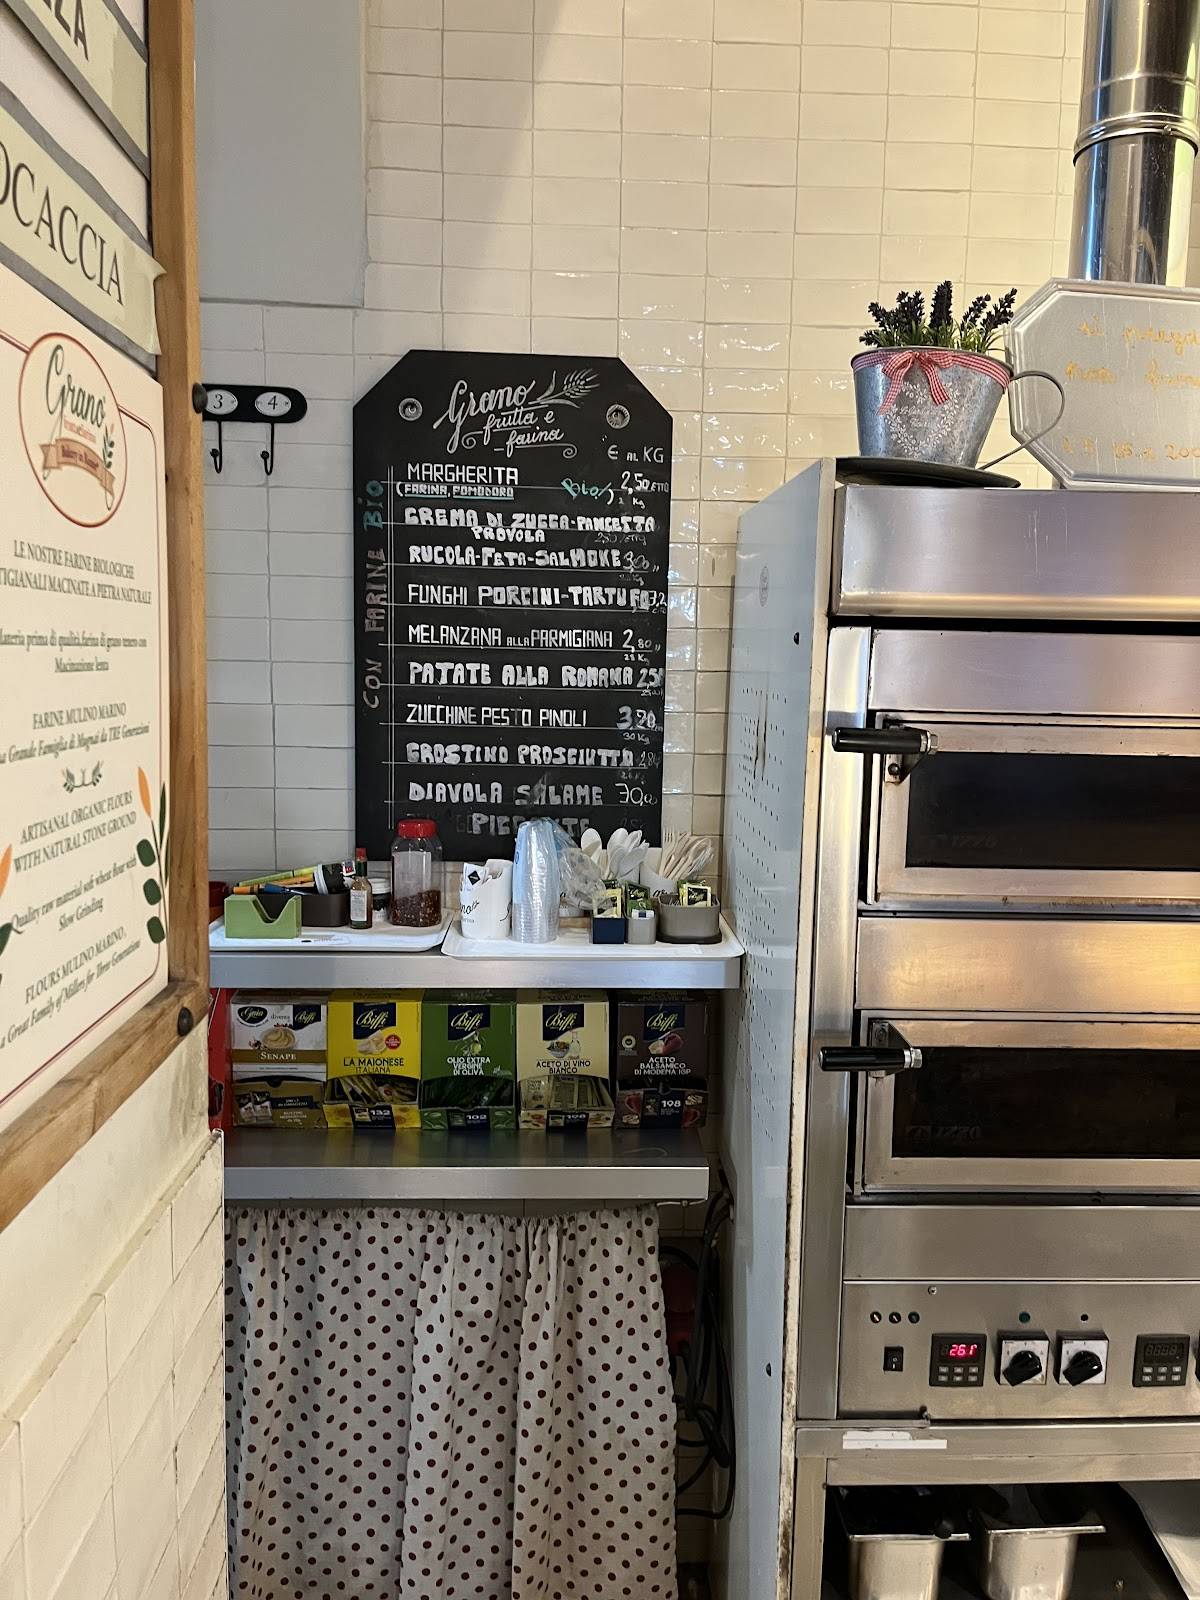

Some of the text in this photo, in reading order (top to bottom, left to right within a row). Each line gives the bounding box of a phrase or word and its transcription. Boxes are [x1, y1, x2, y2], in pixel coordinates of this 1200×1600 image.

[43, 0, 89, 61] ZA
[213, 393, 223, 410] 3
[267, 395, 278, 410] 4
[432, 380, 536, 454] Grano
[482, 406, 556, 446] frutta e
[505, 426, 565, 458] farina
[626, 452, 639, 462] AL
[643, 446, 664, 463] KG
[407, 462, 519, 486] MARGHERITA
[452, 485, 514, 500] POMODORO
[404, 507, 479, 527] CREMA
[486, 512, 503, 528] DI
[471, 525, 546, 543] PROVOLA
[14, 539, 135, 580] LE NOSTRE FARINE BIOLOGICHE
[48, 574, 90, 597] MACINATE
[97, 583, 121, 600] PIETRA
[364, 548, 388, 634] FARINE
[408, 583, 468, 606] FUNGHI
[408, 624, 502, 646] MELANZANA
[506, 635, 530, 647] ALLA
[530, 629, 613, 648] PARMIGIANA
[363, 658, 383, 710] CON
[408, 661, 492, 685] PATATE
[501, 664, 549, 687] ALLA
[561, 665, 634, 689] ROMANA
[33, 702, 127, 730] FARINE MULINO MARINO
[405, 703, 478, 724] ZUCCHINE
[481, 707, 532, 726] PESTO
[539, 708, 587, 727] PINOLI
[406, 742, 509, 766] CROSTINO
[517, 744, 634, 767] PROSCIUTTO
[408, 782, 503, 804] DIAVOLA
[514, 784, 604, 806] SALAME
[20, 812, 70, 844] ARTISANAL
[70, 799, 106, 826] ORGANIC
[13, 811, 137, 873] WITH NATURAL STONE GROUND
[25, 967, 61, 1005] FLOURS
[355, 1008, 389, 1030] Biffi
[450, 1010, 483, 1032] Biffi
[545, 1012, 577, 1031] Biffi
[646, 1012, 679, 1032] Biffi
[343, 1057, 405, 1067] LA MAIONESE
[446, 1056, 491, 1064] OLIO EXTRA
[536, 1060, 591, 1068] ACETO DI VINO
[648, 1056, 676, 1064] ACETO
